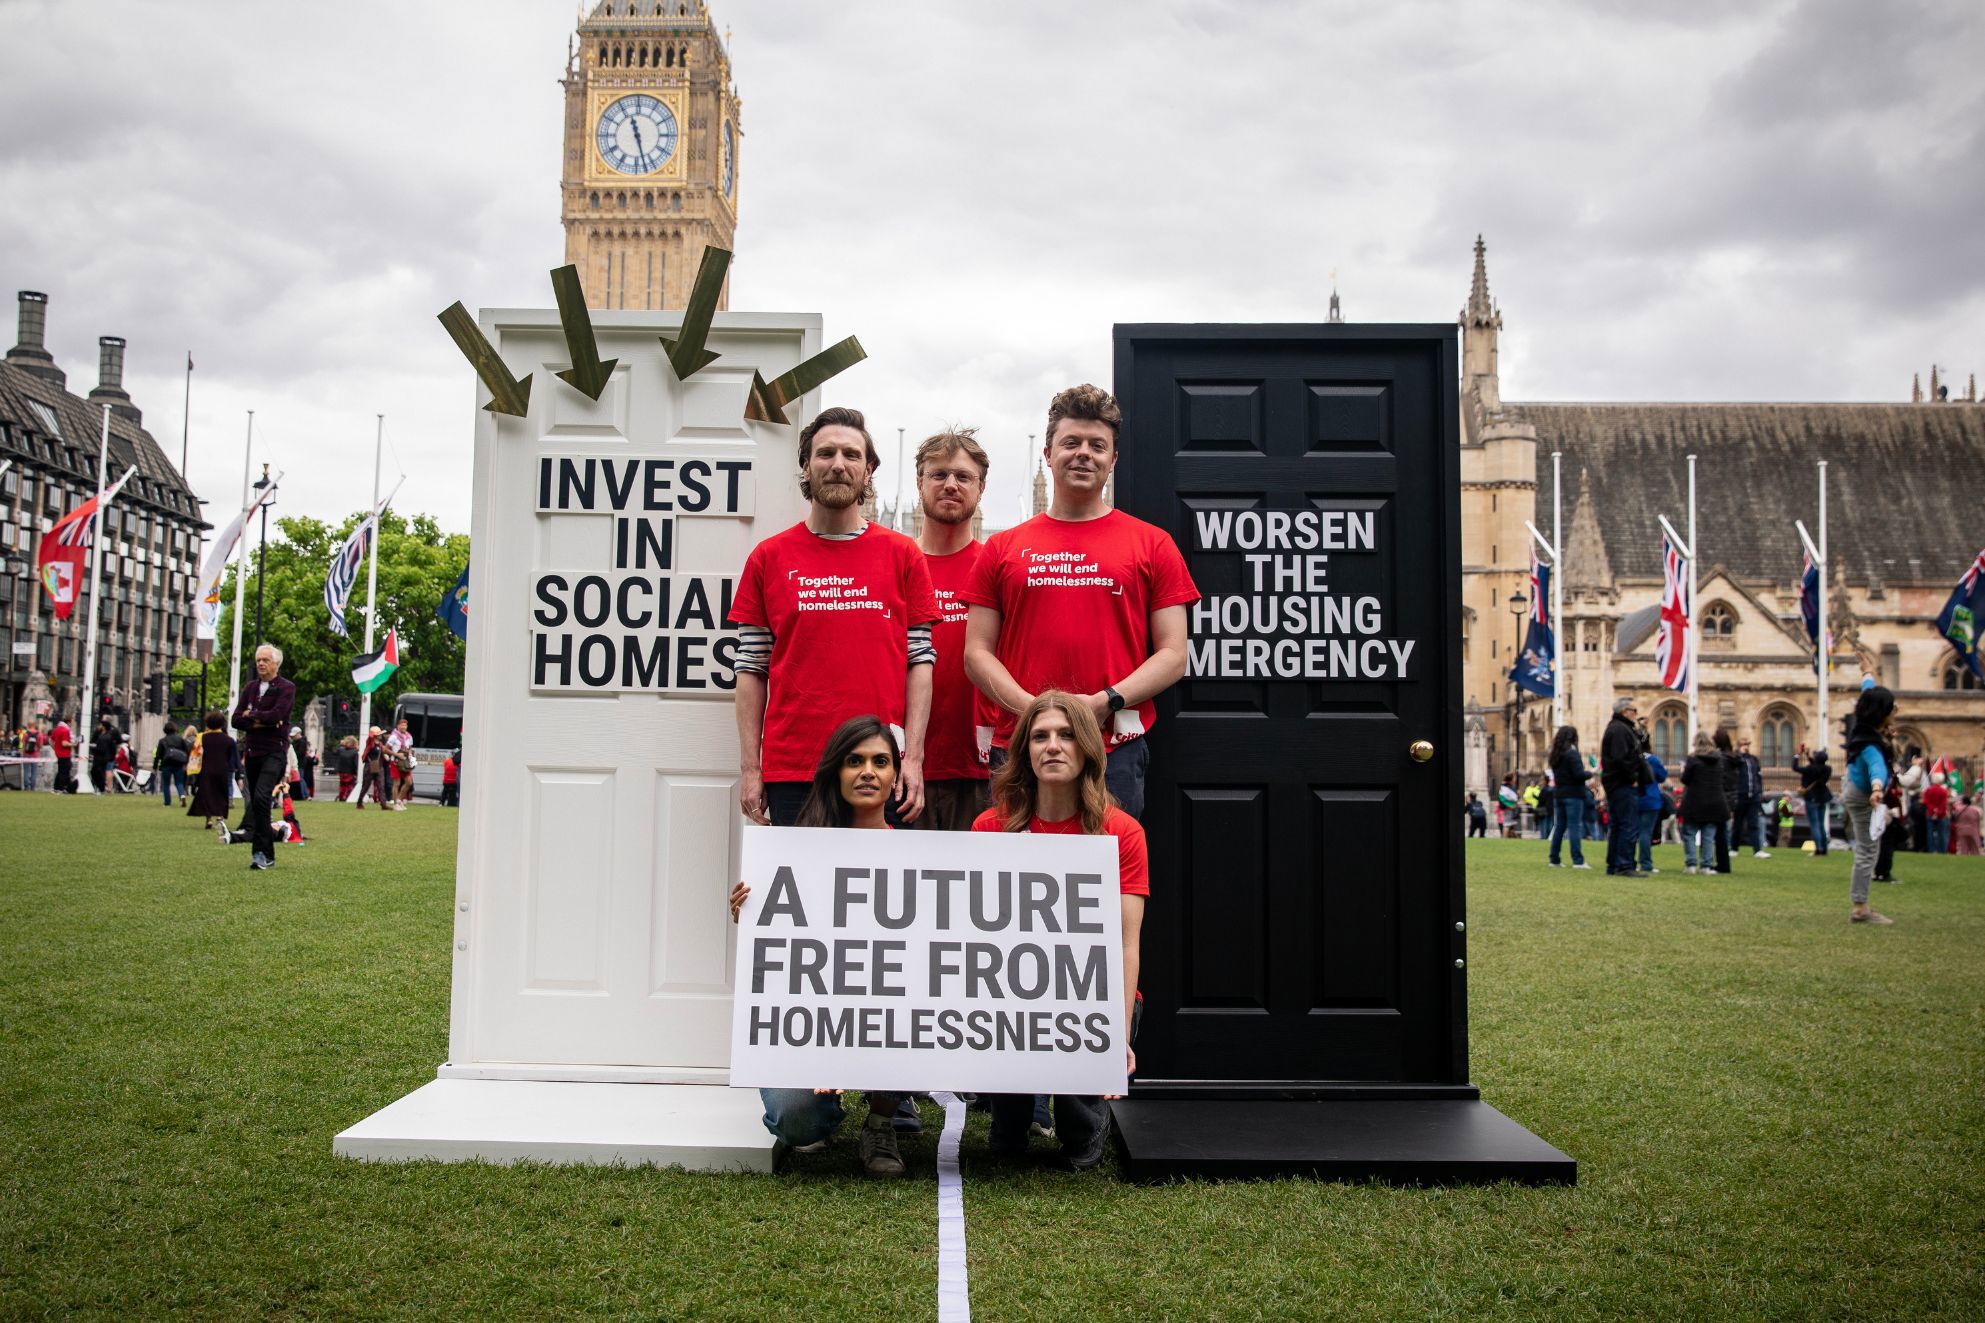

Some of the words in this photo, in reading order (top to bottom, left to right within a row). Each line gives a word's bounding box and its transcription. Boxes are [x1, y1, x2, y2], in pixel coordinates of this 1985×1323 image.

[540, 458, 752, 512] INVEST
[616, 518, 673, 569] IN
[1196, 511, 1375, 549] WORSEN
[1028, 565, 1046, 574] we
[1049, 563, 1072, 574] will
[1074, 563, 1099, 574] end
[1030, 552, 1086, 563] Together
[1245, 554, 1328, 592] THE
[797, 575, 854, 588] Together
[798, 590, 816, 598] we
[818, 587, 841, 598] will
[843, 586, 868, 597] end
[1027, 576, 1114, 587] homelessness
[798, 600, 884, 611] homelessness
[1192, 595, 1382, 634] HOUSING
[534, 633, 742, 690] HOMES
[1184, 639, 1416, 678] MERGENCY
[756, 866, 808, 927] A
[833, 867, 1104, 934] FUTURE
[751, 937, 906, 996] FREE
[928, 941, 1109, 1002] FROM
[749, 1006, 1111, 1053] HOMELESSNESS
